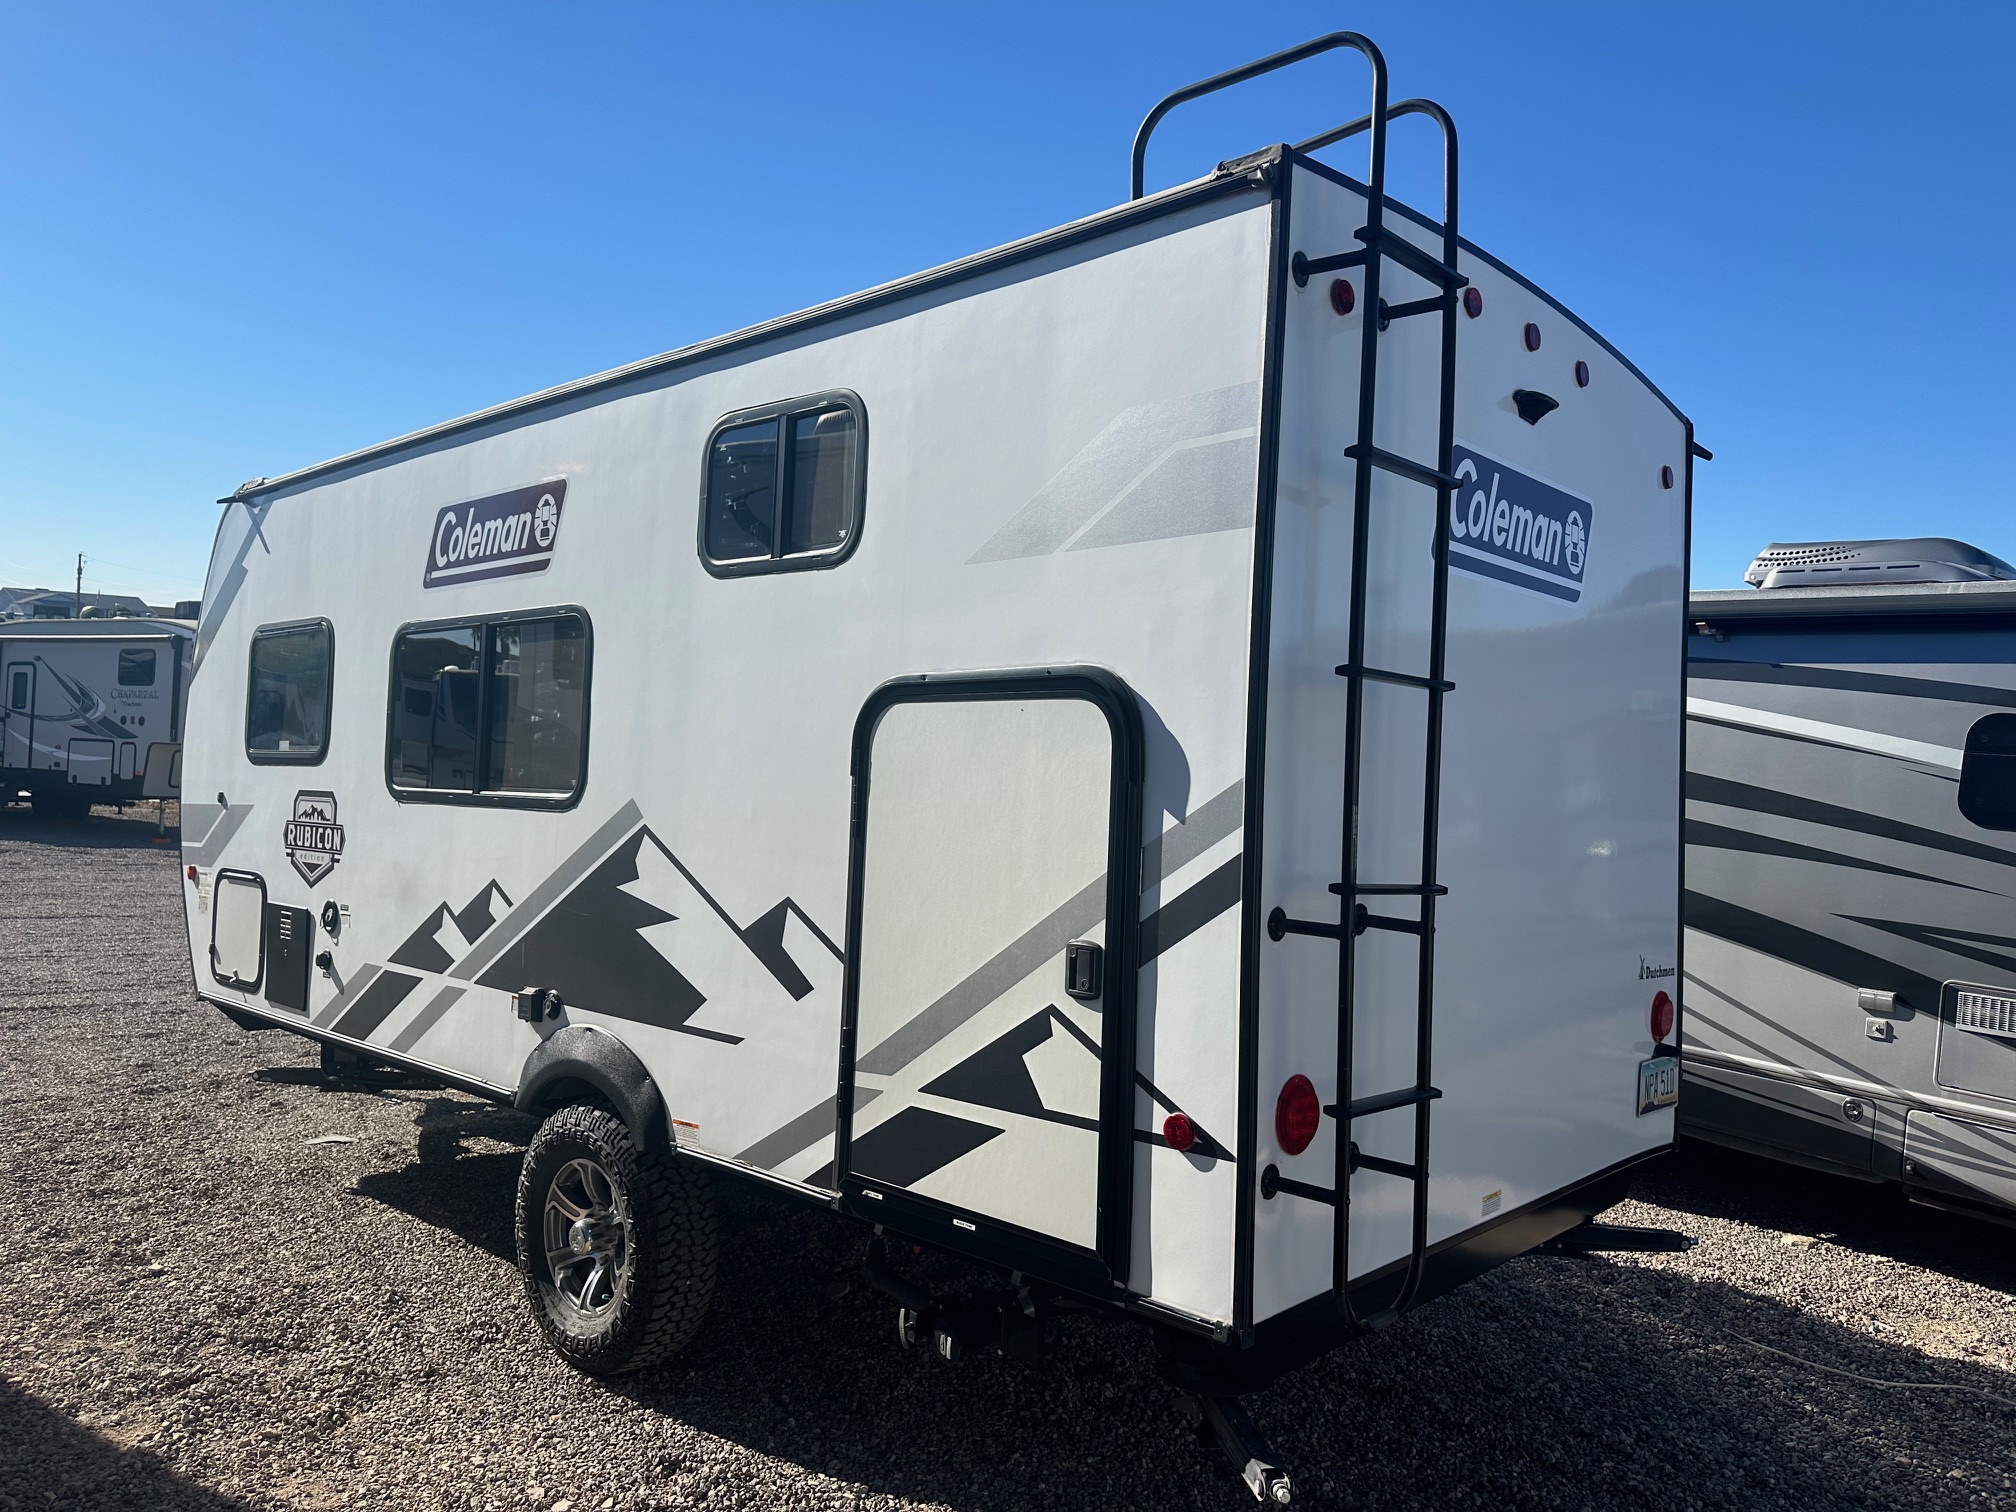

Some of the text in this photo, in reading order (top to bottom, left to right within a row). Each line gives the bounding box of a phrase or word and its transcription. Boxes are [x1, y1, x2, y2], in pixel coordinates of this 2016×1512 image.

[1450, 458, 1563, 566] Coleman
[435, 507, 532, 567] Coleman
[110, 688, 159, 699] CHAPARRAL
[287, 824, 341, 850] RUBICON
[300, 853, 325, 862] edition
[1645, 964, 1675, 979] Dutchmen
